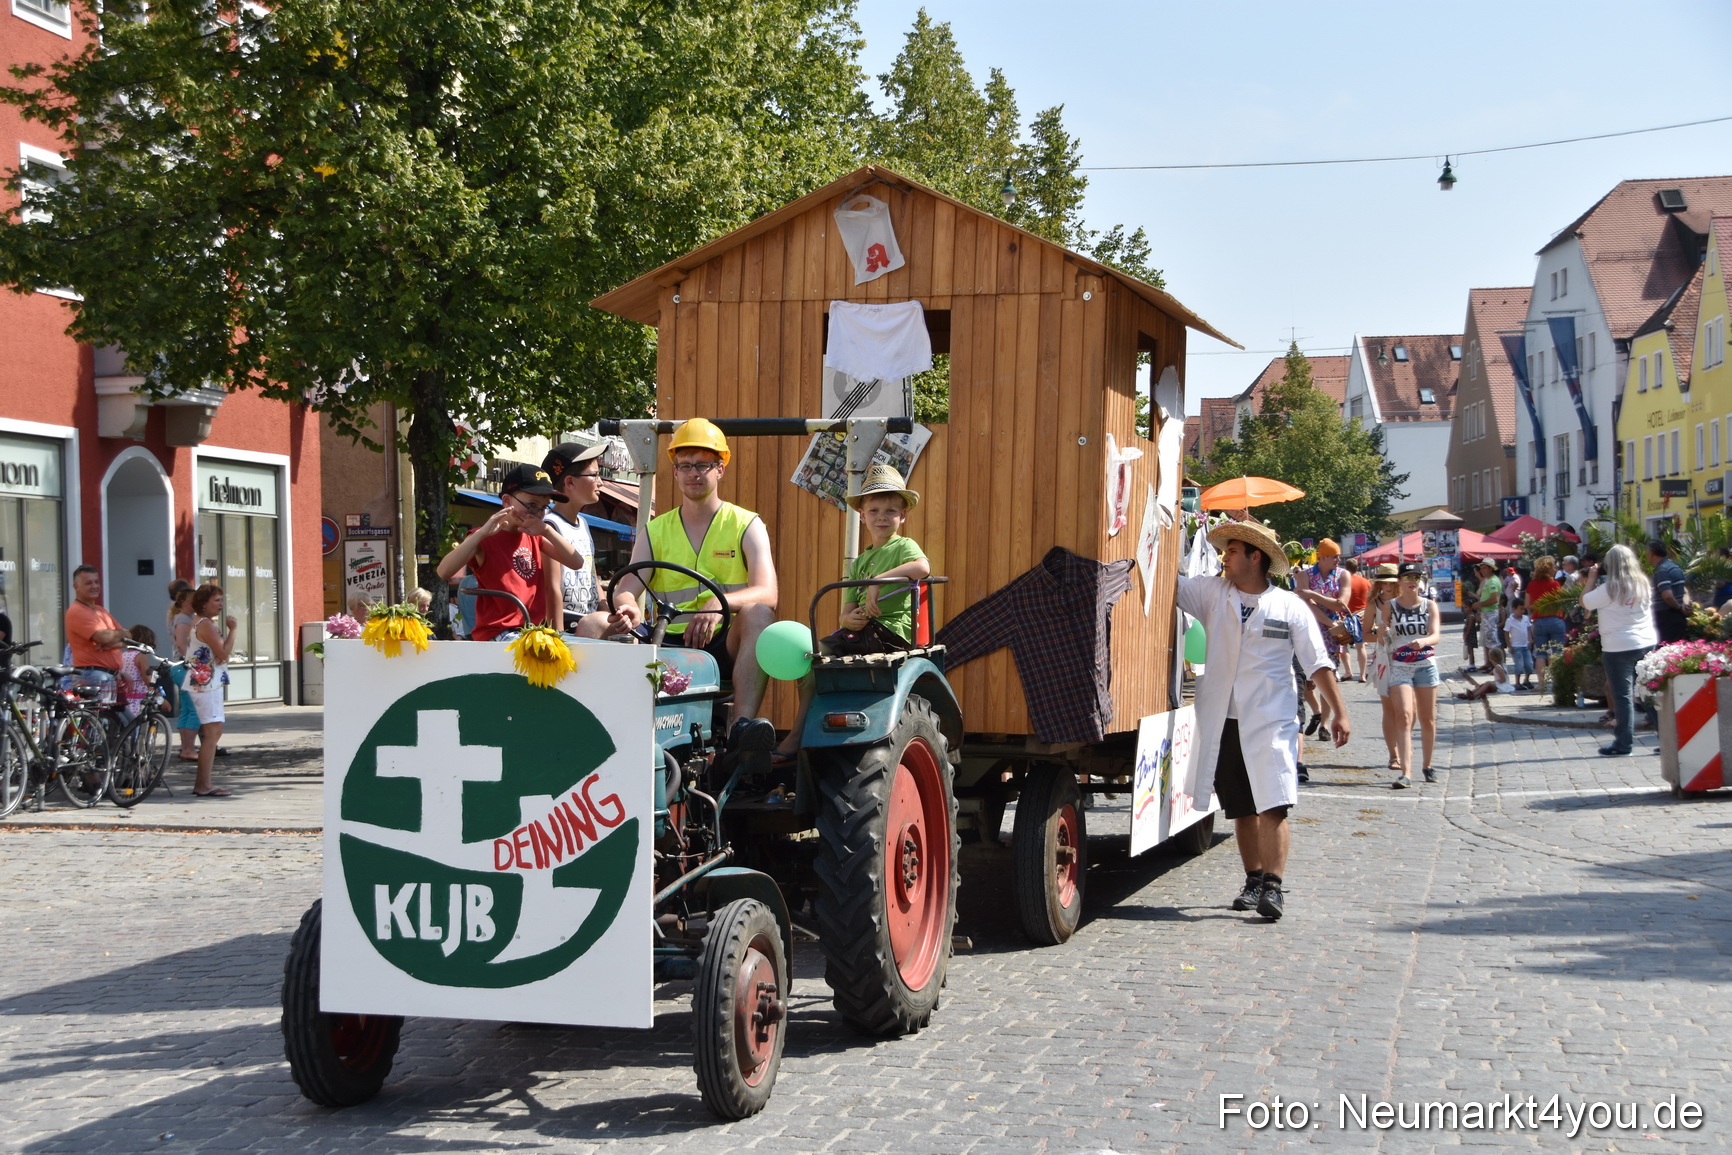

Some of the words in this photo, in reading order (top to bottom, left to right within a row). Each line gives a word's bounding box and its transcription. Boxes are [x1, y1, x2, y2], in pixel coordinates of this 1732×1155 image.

[209, 475, 262, 507] fielmann
[347, 527, 391, 537] Bockwirtsgasse
[347, 567, 386, 585] VENEZIA
[493, 773, 626, 871] DEINING
[373, 882, 497, 958] KLJB
